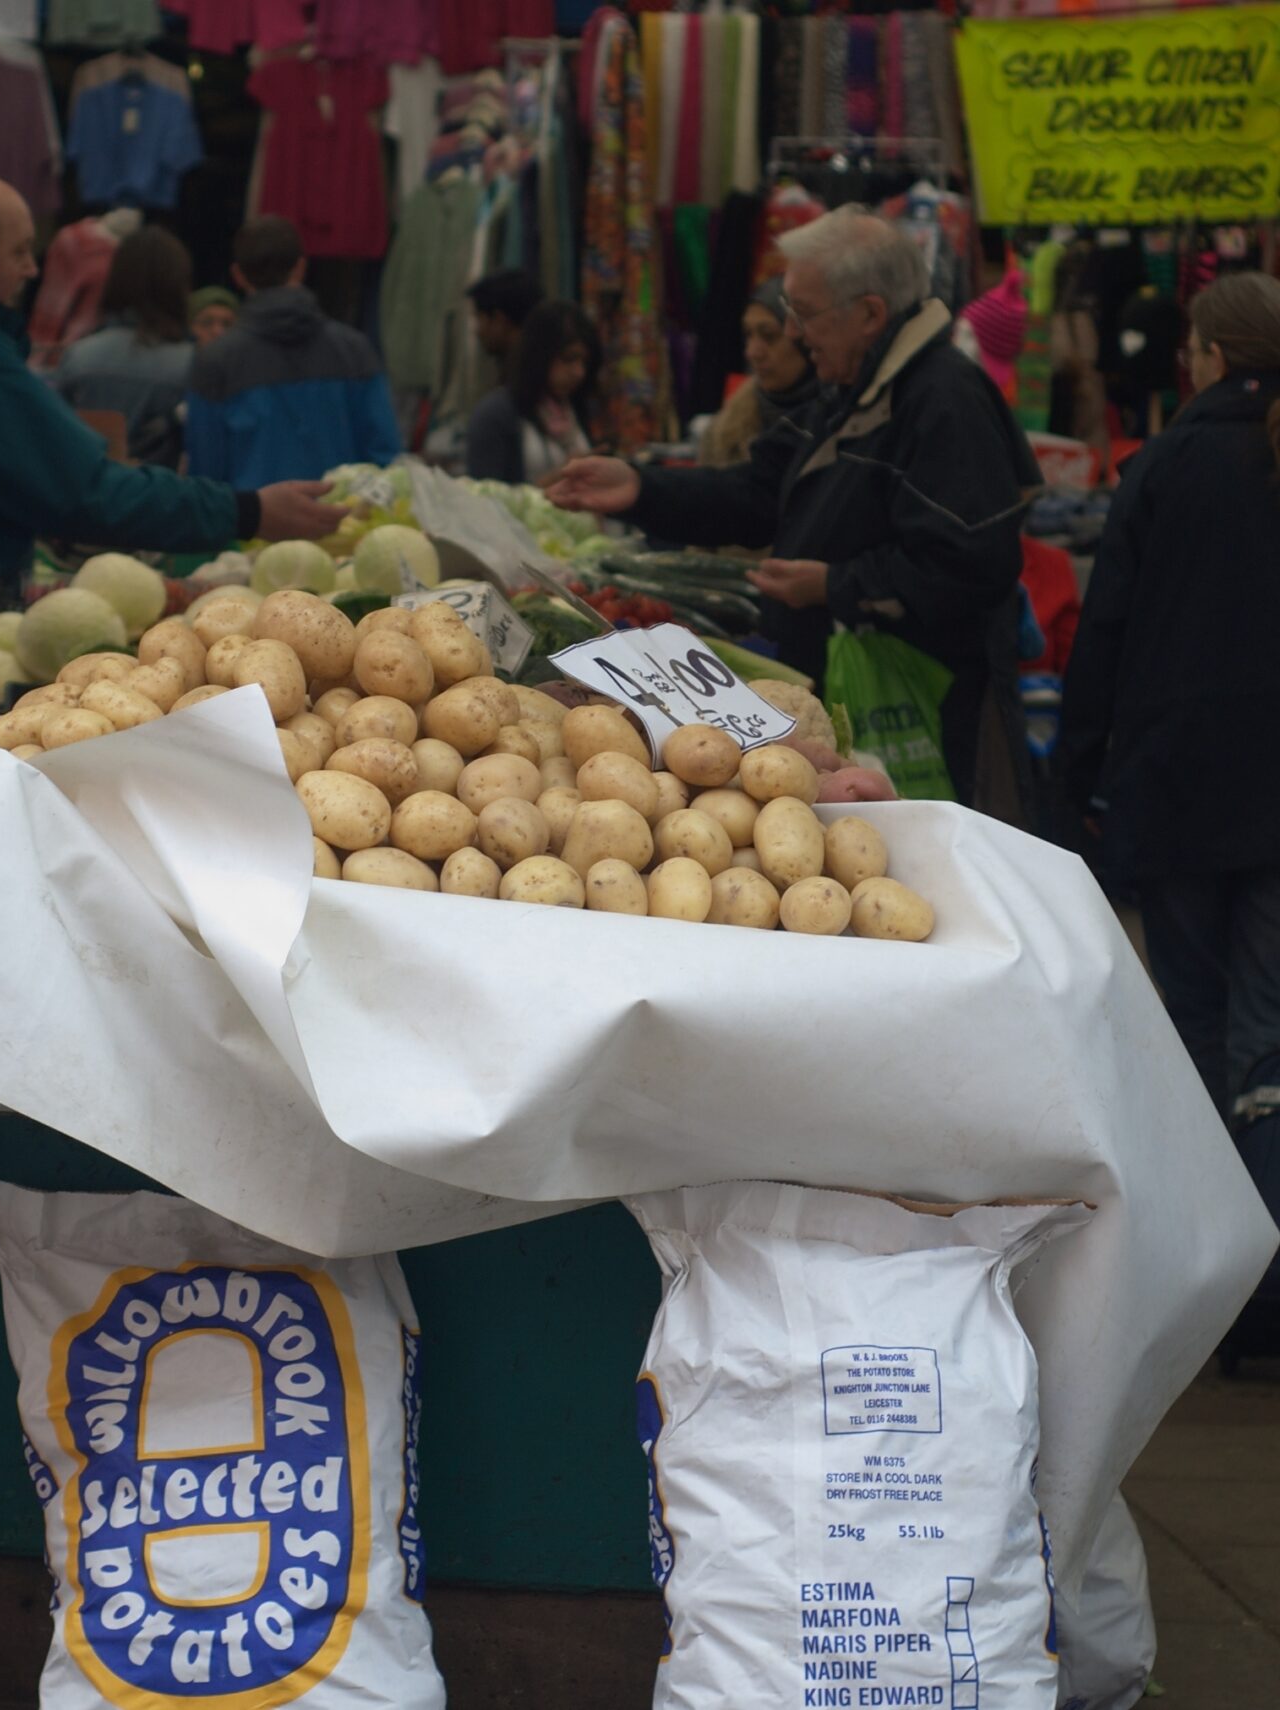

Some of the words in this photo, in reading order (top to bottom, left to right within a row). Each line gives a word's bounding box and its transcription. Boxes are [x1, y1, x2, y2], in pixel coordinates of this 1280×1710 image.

[1046, 96, 1248, 133] DISCOUNTS
[863, 1353, 869, 1361] &
[879, 1353, 909, 1361] BROOKS
[846, 1368, 861, 1377] THE
[863, 1368, 891, 1377] POTATO
[892, 1368, 915, 1377] STORE
[833, 1384, 872, 1394] KNIGHTON
[874, 1383, 910, 1393] JUNCTION
[911, 1383, 931, 1393] LANE
[864, 1399, 903, 1408] LEICESTER
[867, 1415, 885, 1424] 0116
[863, 1456, 882, 1466] WM
[883, 1456, 906, 1467] 6375
[826, 1473, 860, 1483] STORE
[862, 1472, 873, 1483] IN
[875, 1472, 882, 1483] A
[884, 1472, 912, 1484] COOL
[914, 1473, 943, 1485] DARK
[826, 1488, 847, 1499] DRY
[848, 1488, 882, 1500] FROST
[884, 1489, 909, 1500] FREE
[911, 1490, 943, 1501] PLACE
[827, 1524, 866, 1541] 25kg
[801, 1582, 875, 1602] ESTIMA
[802, 1607, 901, 1628] MARFONA
[803, 1634, 867, 1654] MARIS
[874, 1633, 932, 1652] PIPER
[804, 1660, 877, 1680] NADINE
[805, 1687, 851, 1707] KING
[859, 1685, 944, 1706] EDWARD
